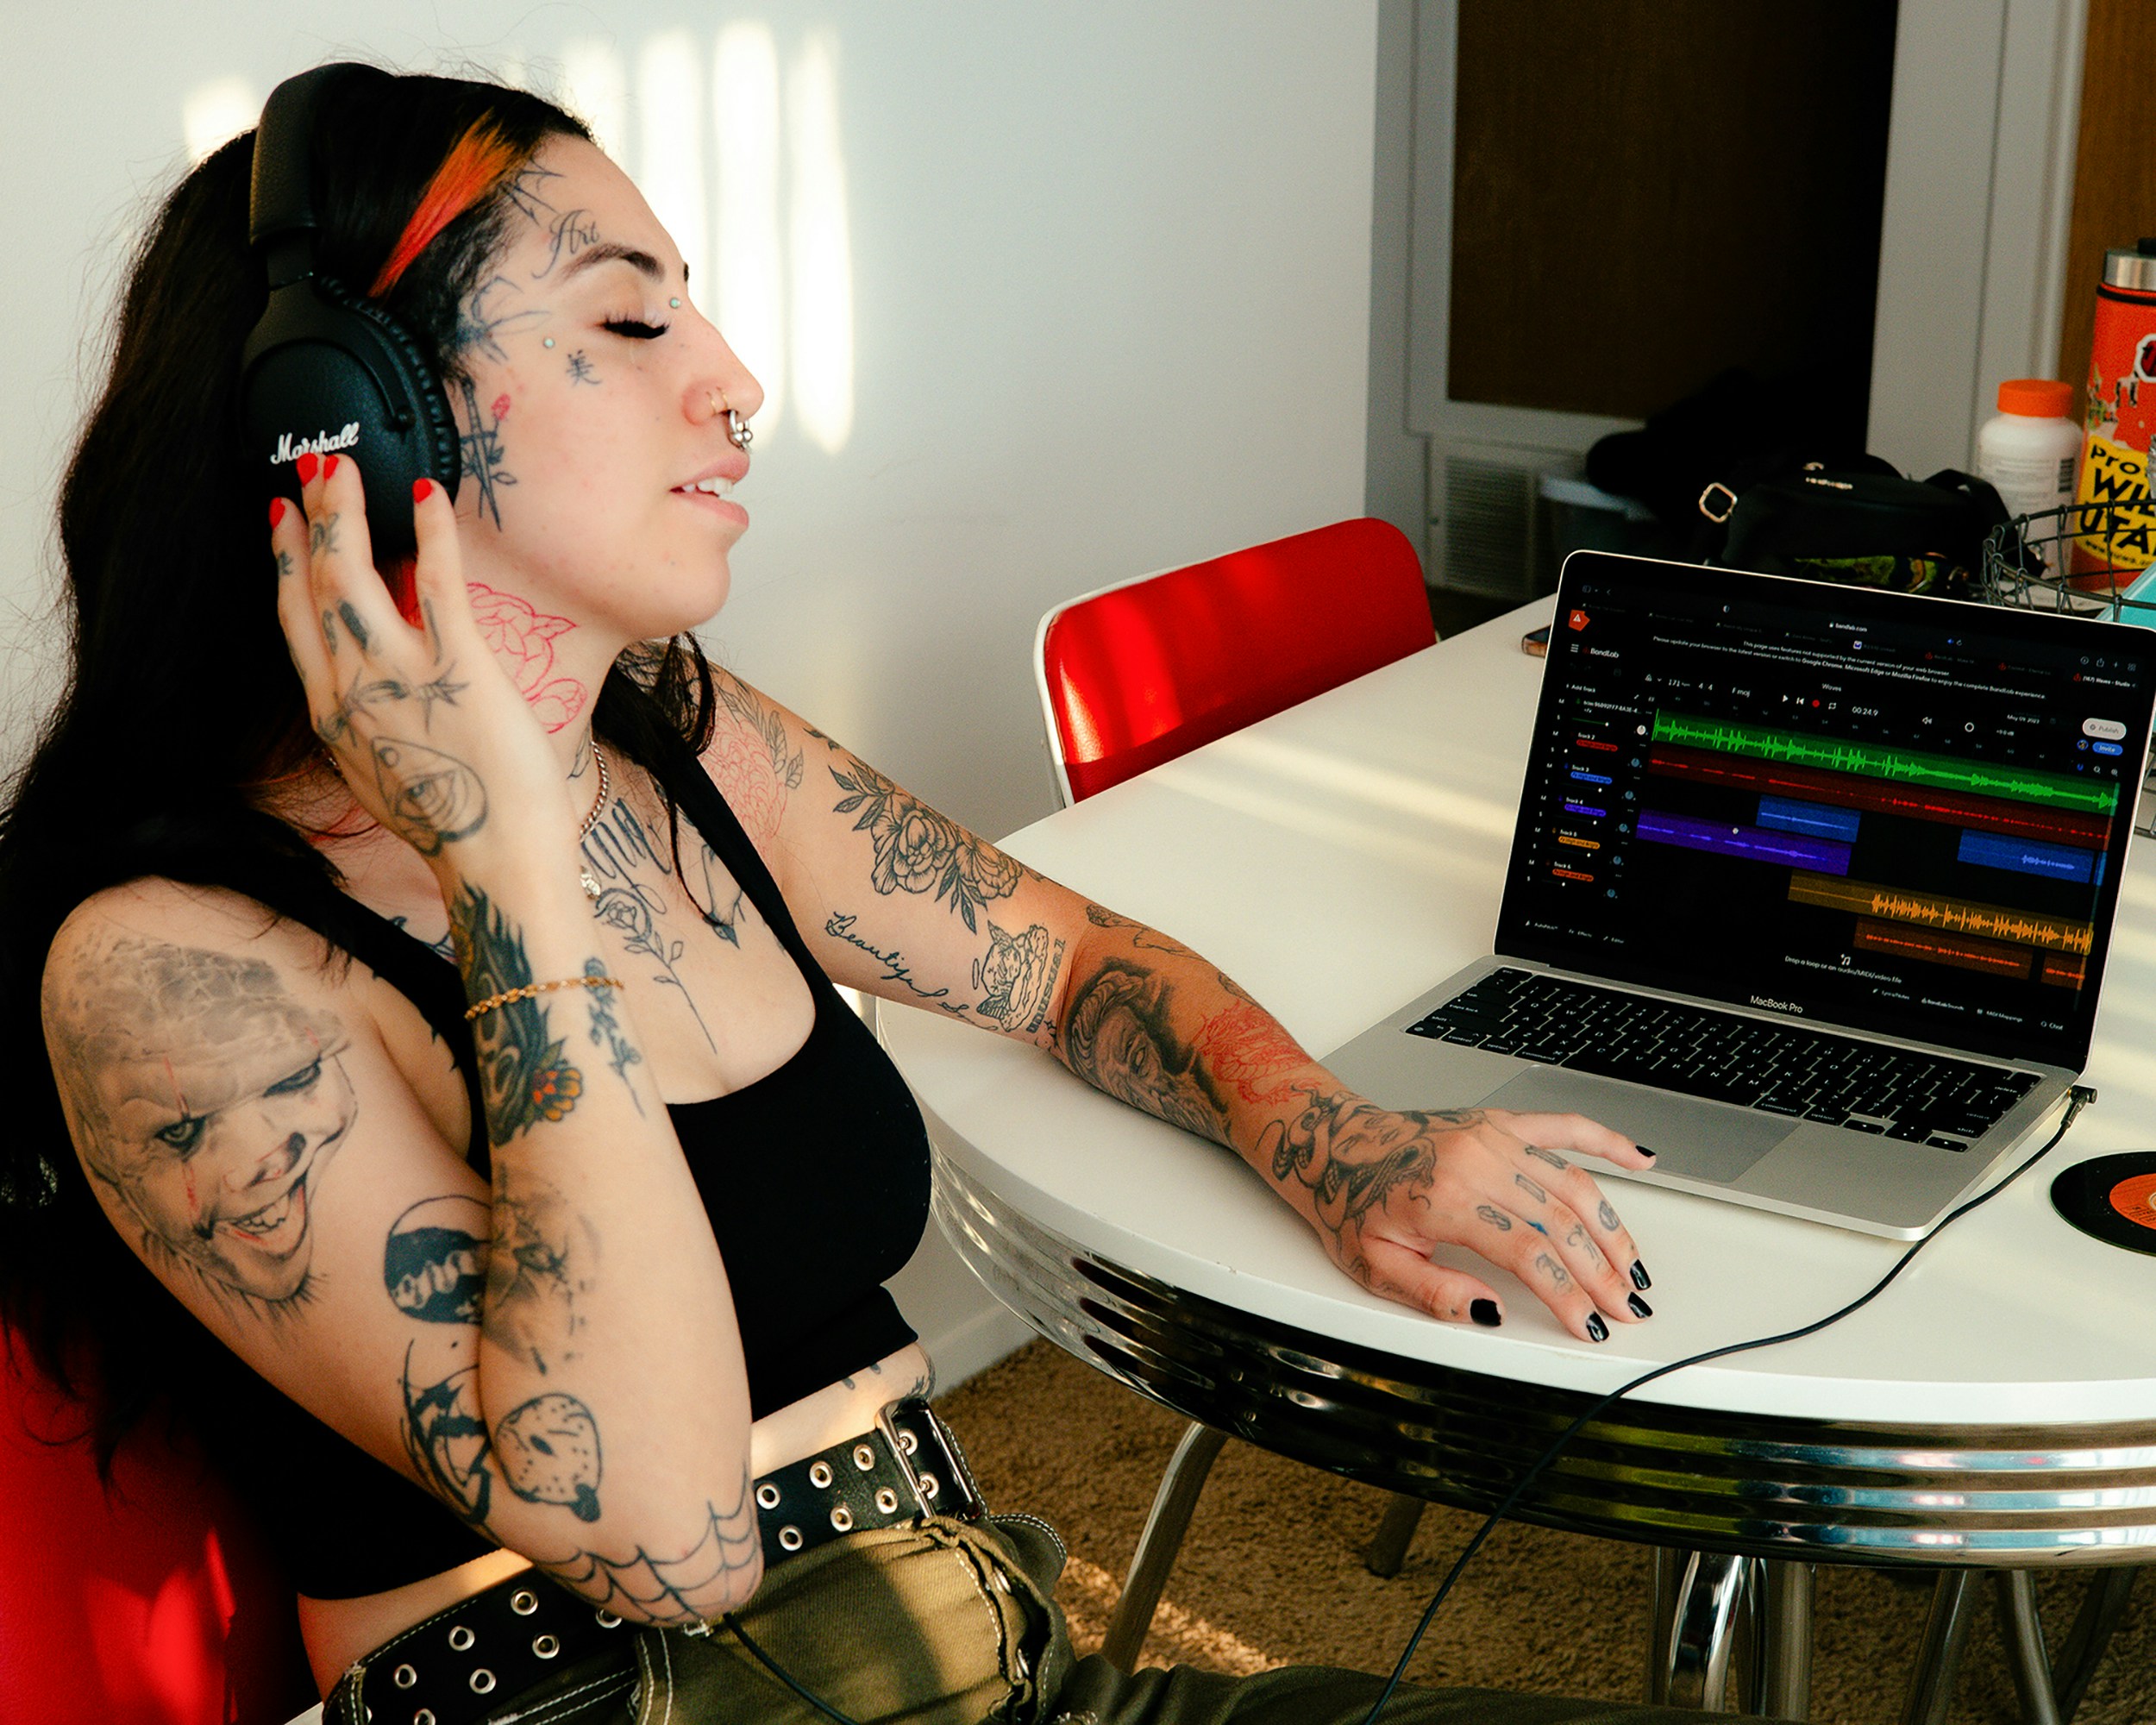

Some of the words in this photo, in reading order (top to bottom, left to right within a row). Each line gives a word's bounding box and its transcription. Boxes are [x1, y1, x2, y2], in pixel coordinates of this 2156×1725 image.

[270, 421, 360, 464] Marshall
[2080, 502, 2156, 556] UTA
[1590, 648, 1619, 658] BandLab
[824, 912, 949, 998] Beautiful
[1751, 995, 1788, 1010] MacBook
[1789, 1003, 1802, 1013] Pro
